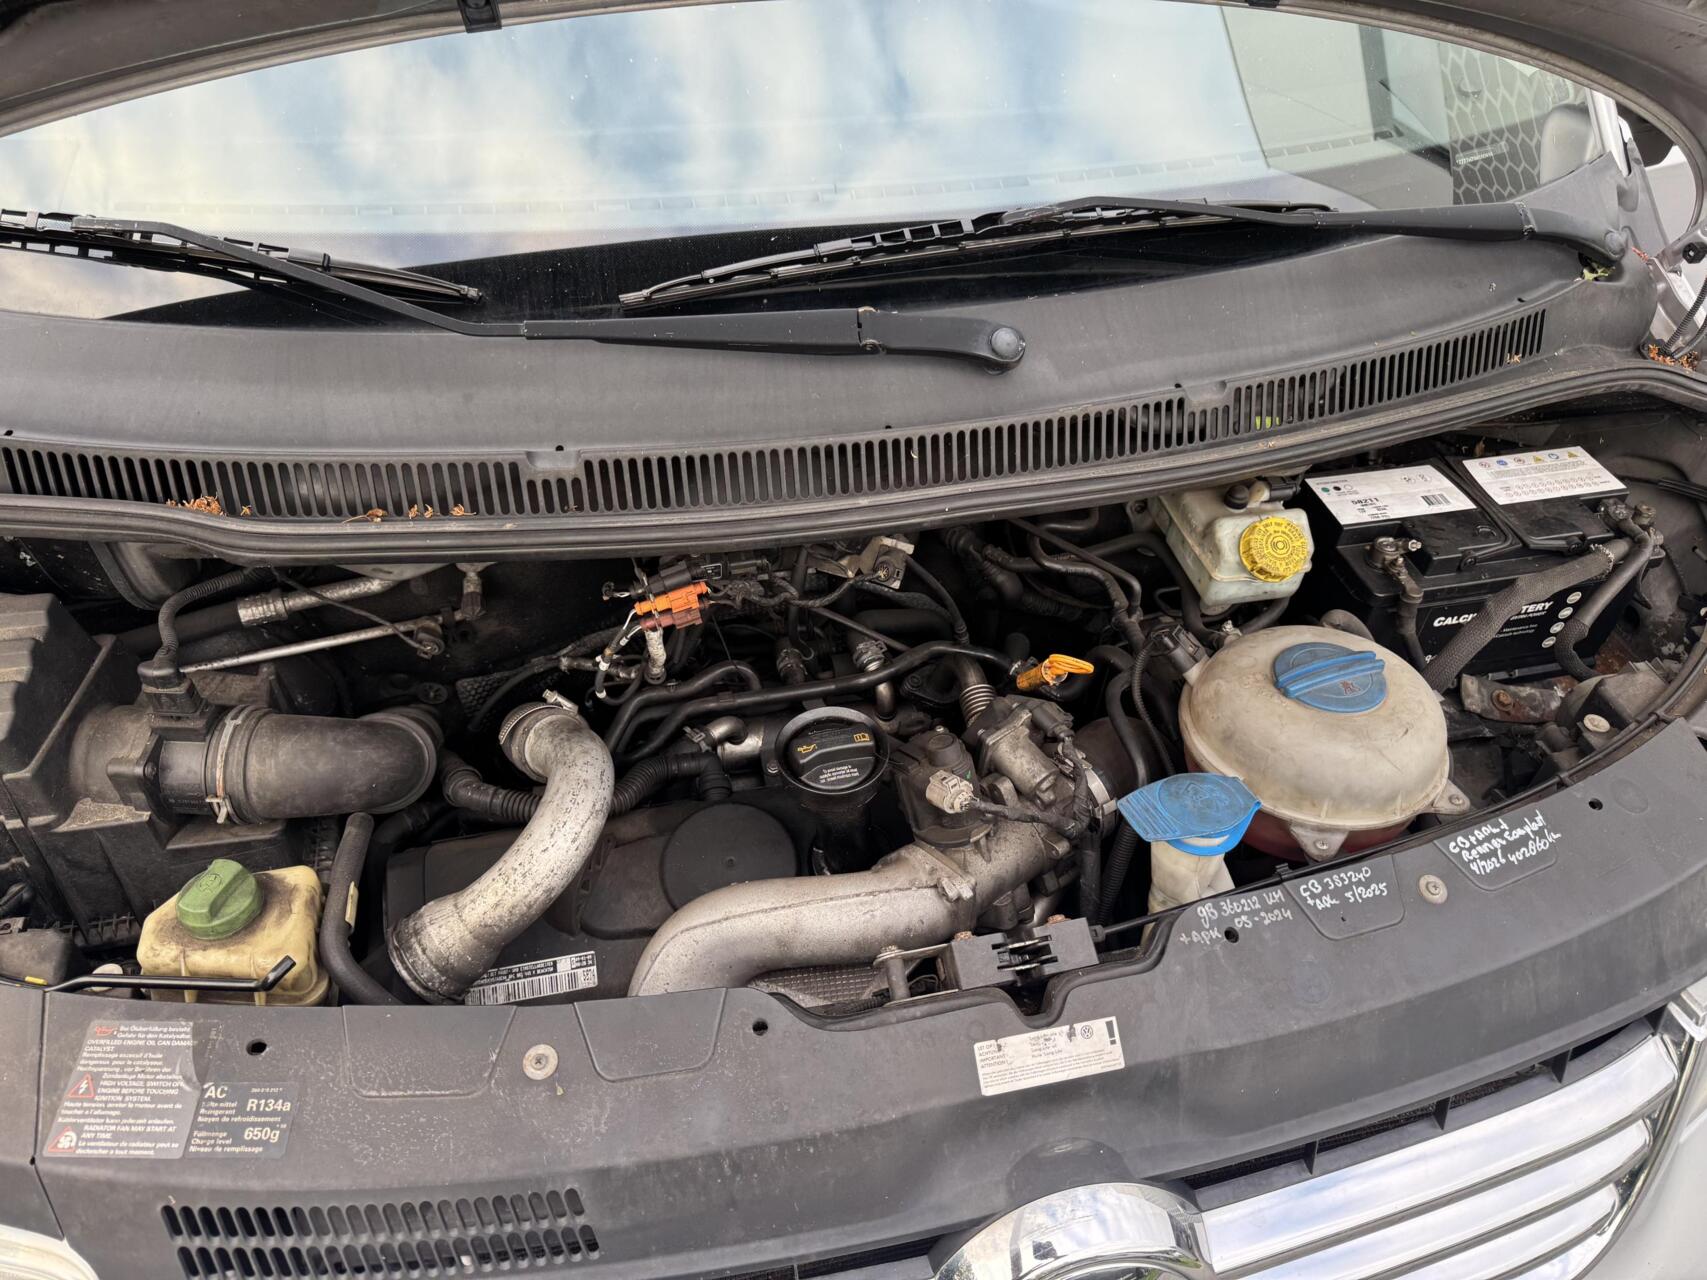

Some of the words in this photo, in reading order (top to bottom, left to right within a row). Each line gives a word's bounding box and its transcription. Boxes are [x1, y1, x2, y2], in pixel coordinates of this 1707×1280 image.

[1433, 612, 1477, 627] CALCI
[1521, 601, 1553, 614] TERY
[204, 1085, 228, 1099] AC
[246, 1098, 291, 1112] R134a
[244, 1127, 280, 1143] 650g
